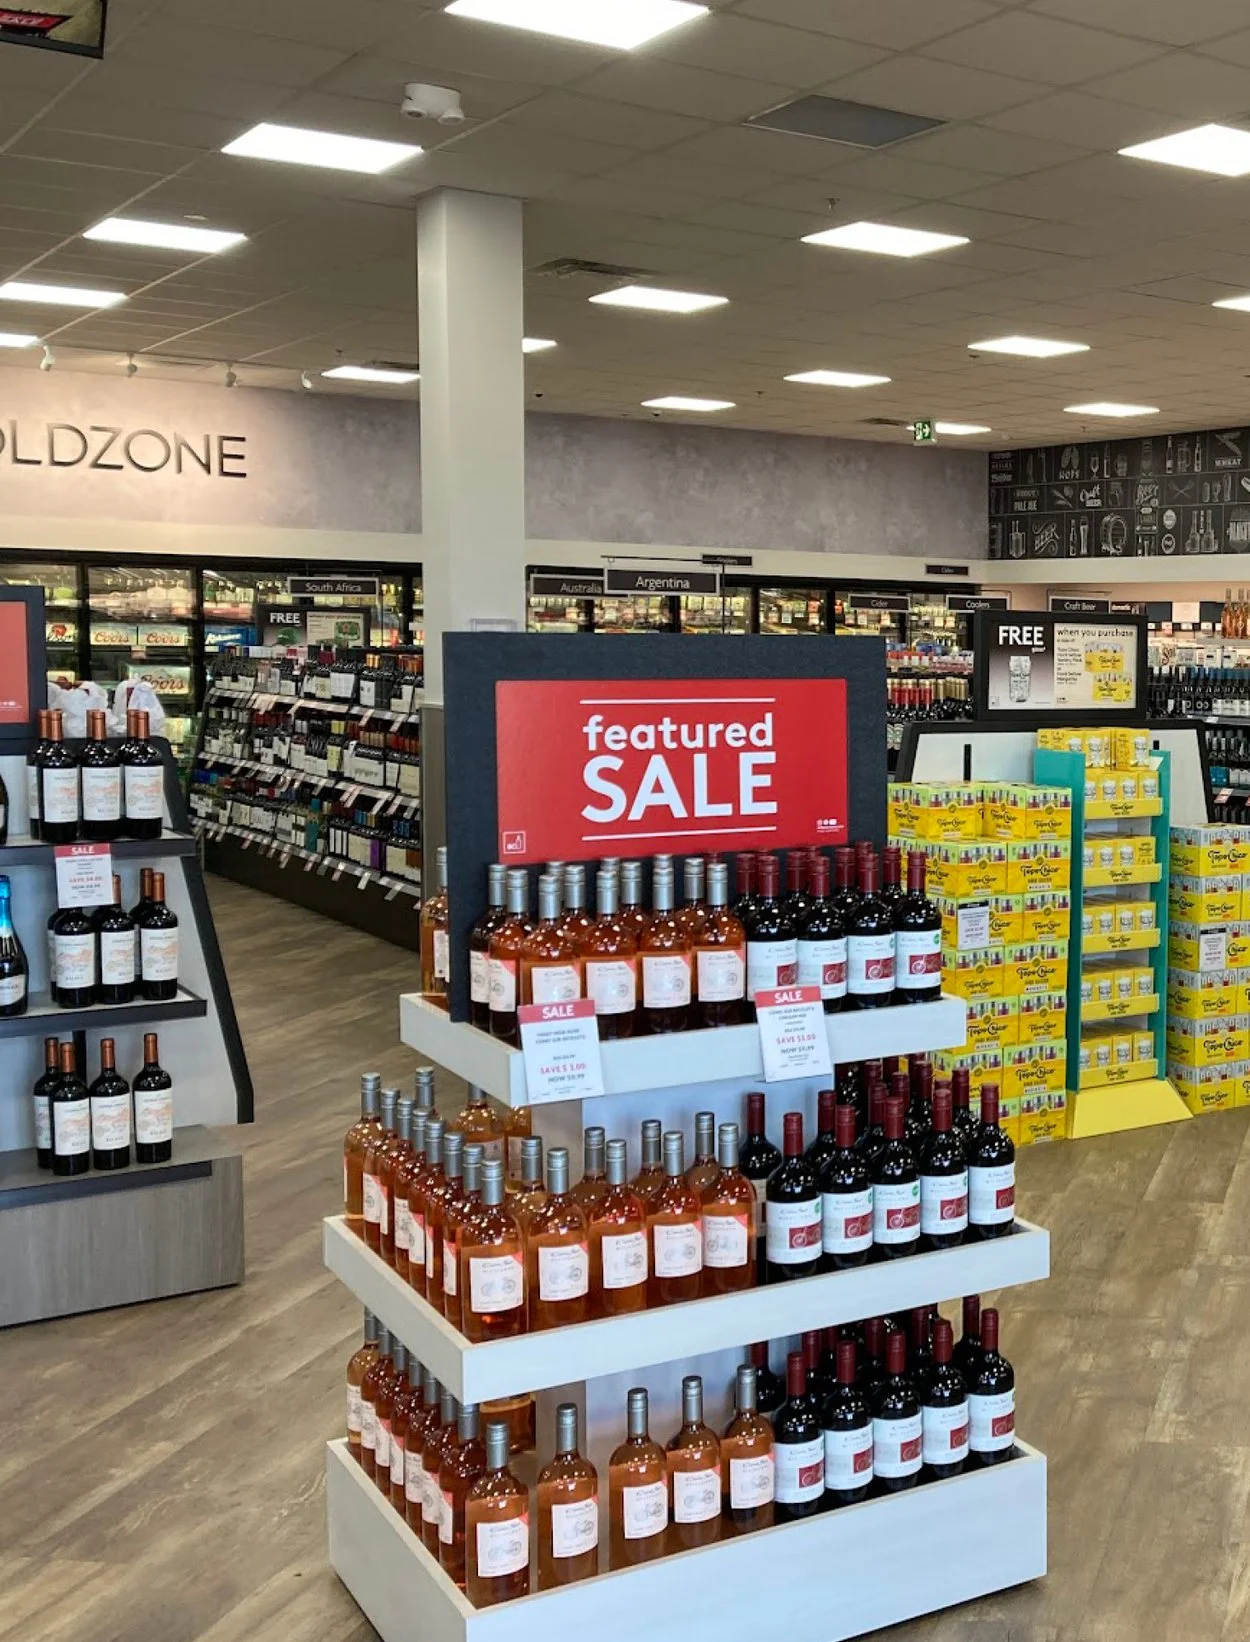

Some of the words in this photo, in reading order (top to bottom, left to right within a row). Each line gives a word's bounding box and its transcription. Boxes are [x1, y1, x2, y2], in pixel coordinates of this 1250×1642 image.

[0, 420, 247, 477] LDZONE
[305, 583, 333, 592] South
[335, 583, 362, 592] Africa
[560, 582, 601, 593] Australia
[635, 576, 690, 590] Argentina
[871, 600, 888, 609] Cider
[966, 600, 991, 609] Coolers
[1064, 602, 1080, 611] Craft
[1080, 602, 1096, 611] Beer
[270, 612, 300, 623] FREE
[94, 631, 130, 644] Coors
[144, 631, 181, 644] Coors
[998, 625, 1044, 645] FREE
[1057, 628, 1079, 637] when
[1081, 629, 1097, 638] you
[1098, 628, 1134, 638] purchase
[582, 712, 774, 751] featured
[581, 751, 778, 823] SALE
[71, 845, 95, 856] SALE
[1016, 966, 1036, 979] Topo
[774, 990, 803, 1004] SALE
[542, 1004, 575, 1020] SALE
[967, 1024, 988, 1038] Topo
[1016, 1068, 1036, 1081] Topo
